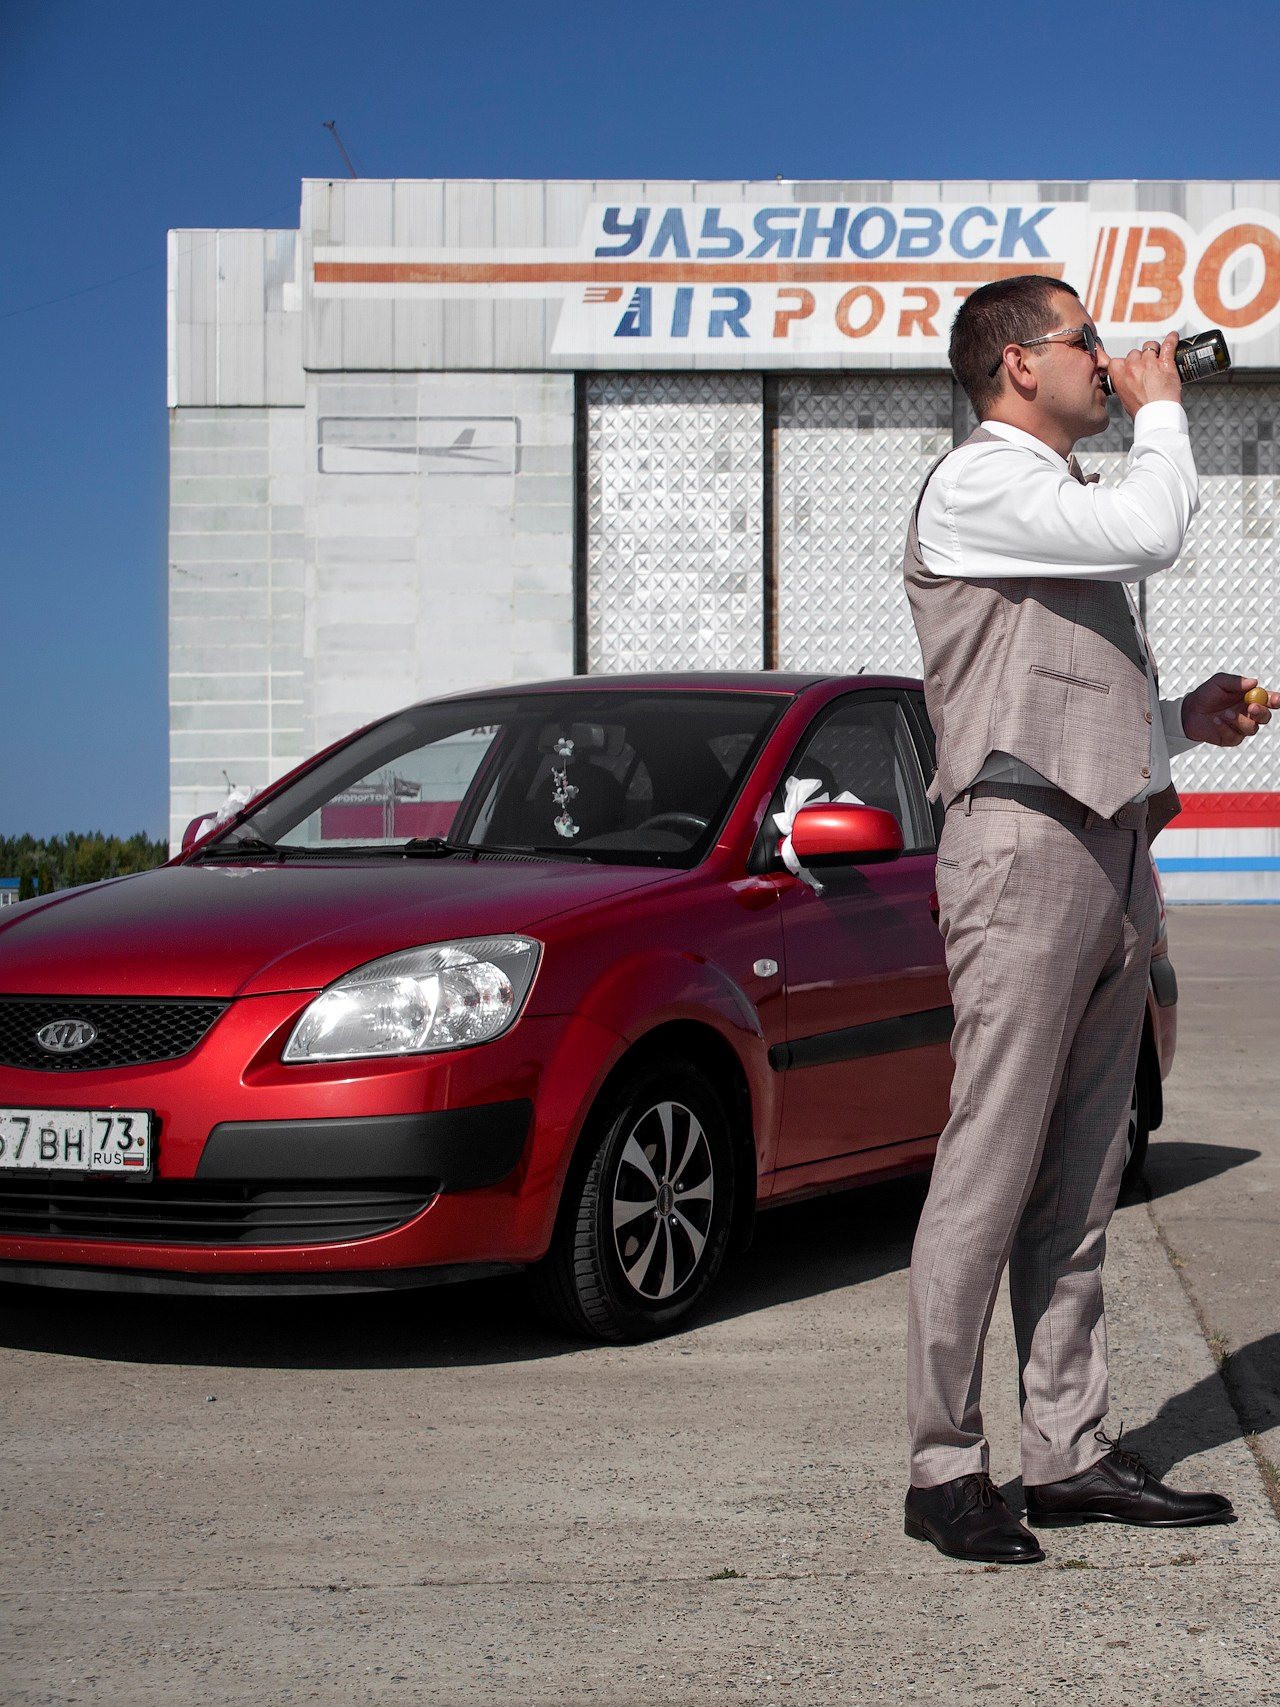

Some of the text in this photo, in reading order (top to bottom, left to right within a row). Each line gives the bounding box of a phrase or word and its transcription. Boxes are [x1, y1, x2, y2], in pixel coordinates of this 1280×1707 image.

[595, 206, 1056, 259] УЛЬЯНОВСК
[613, 285, 977, 338] AIRPOR
[45, 1023, 85, 1048] KIA
[97, 1117, 134, 1150] 73
[93, 1152, 122, 1165] RUS
